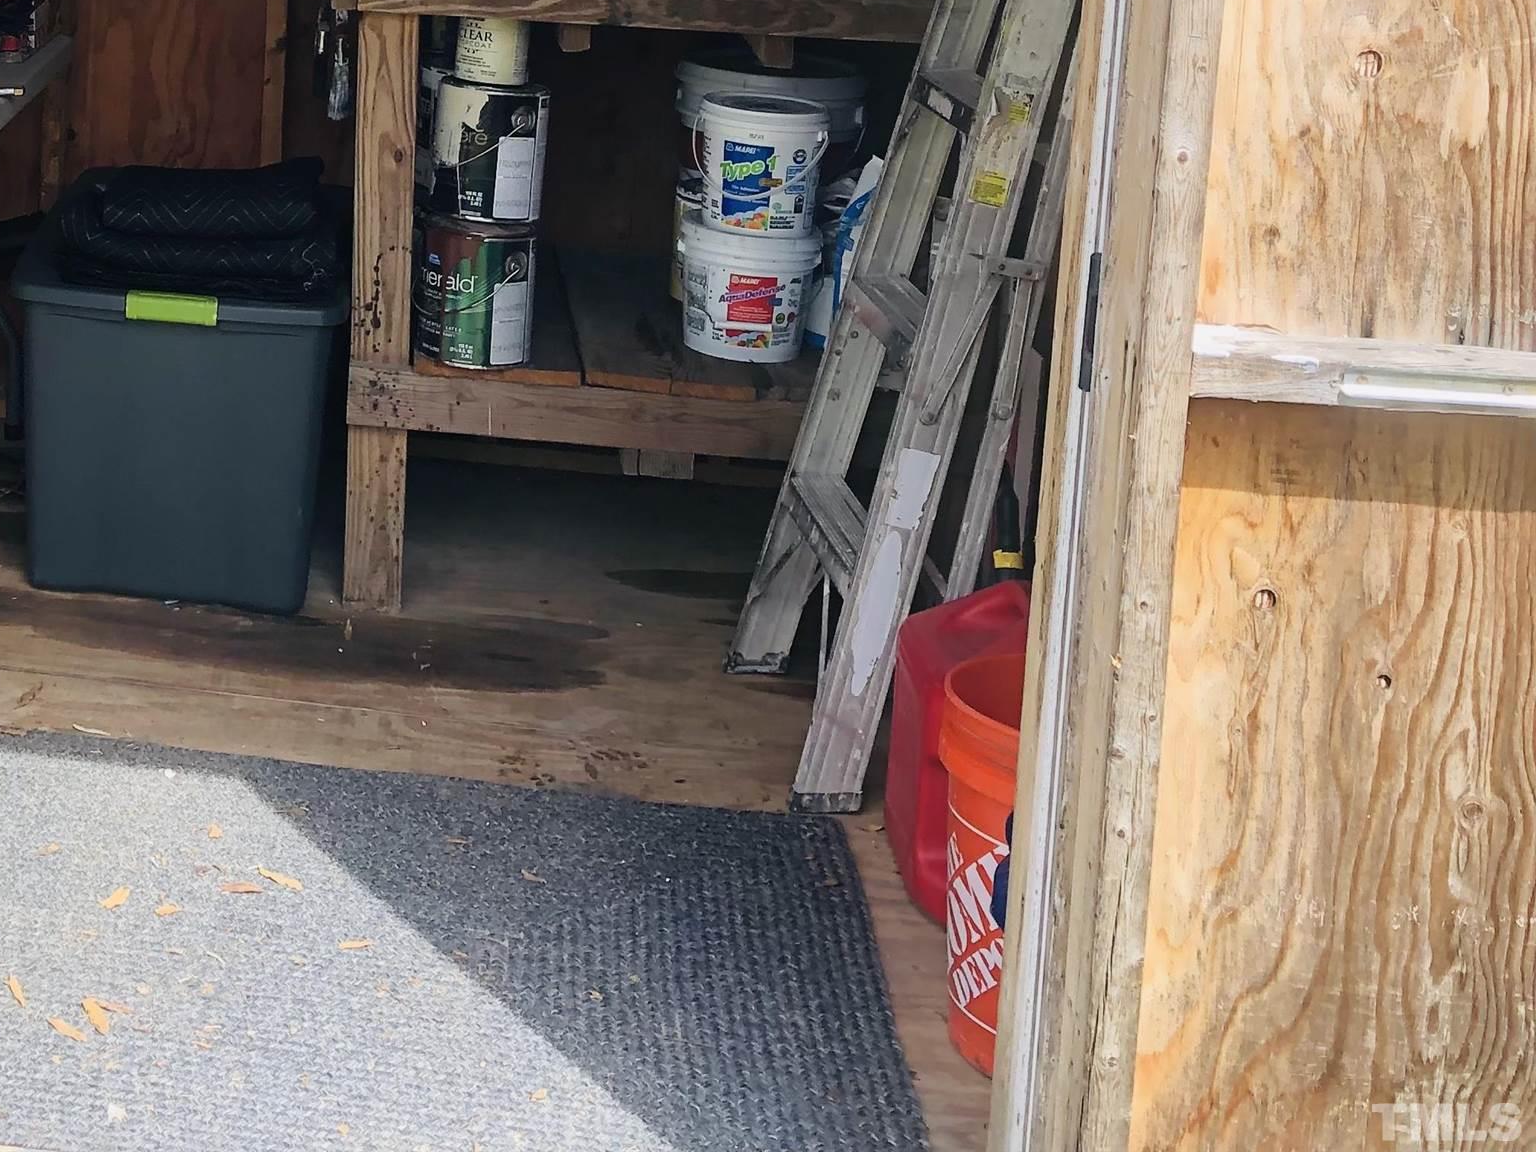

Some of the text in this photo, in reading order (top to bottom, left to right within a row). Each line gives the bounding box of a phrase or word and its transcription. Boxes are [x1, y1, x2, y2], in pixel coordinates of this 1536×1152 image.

[735, 144, 758, 155] MAPEI
[720, 153, 779, 183] Type 1
[739, 277, 762, 285] MAPEI
[718, 284, 787, 304] AquaDefense
